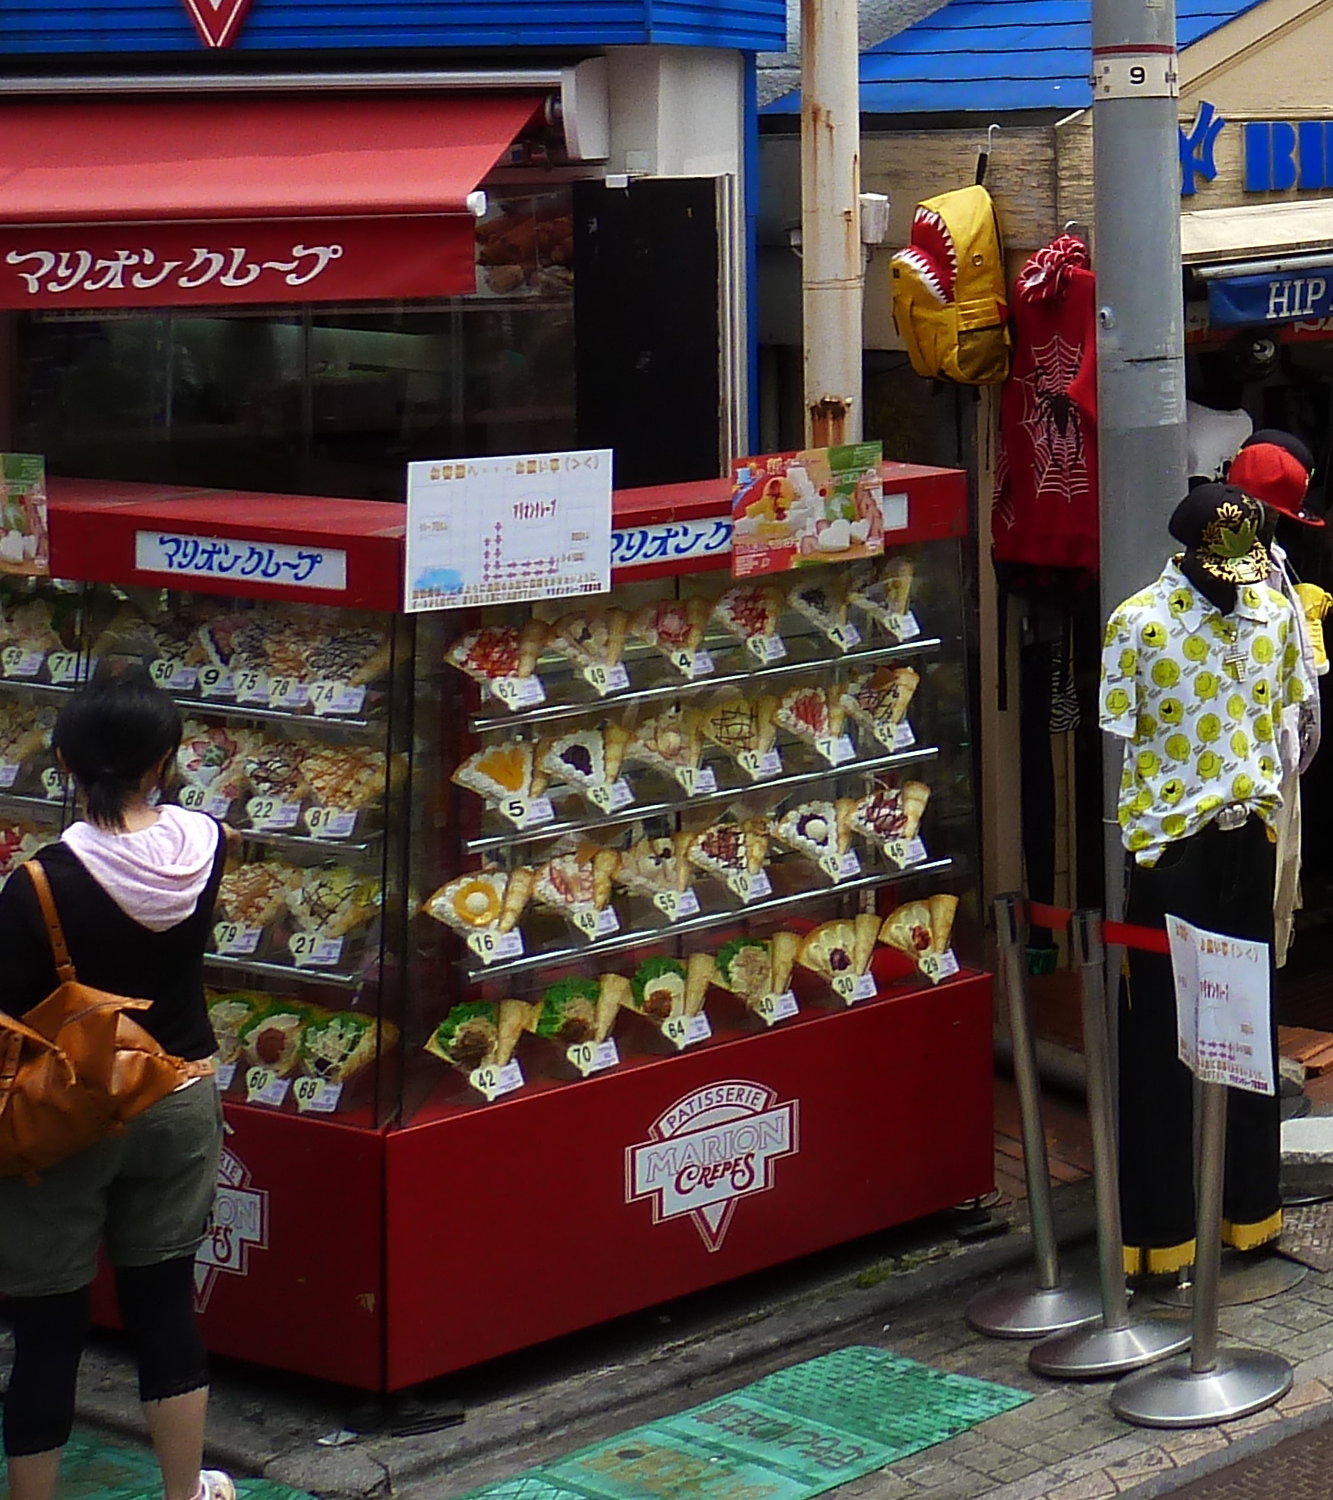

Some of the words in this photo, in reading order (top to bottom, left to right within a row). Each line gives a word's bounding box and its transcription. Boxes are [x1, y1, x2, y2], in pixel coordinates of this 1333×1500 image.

[1130, 66, 1146, 85] 9
[6, 245, 343, 294] マリオンクレープ
[1266, 277, 1326, 320] HIP
[611, 521, 733, 564] マリオンク
[159, 536, 323, 581] マリオンクレープ
[54, 655, 72, 672] 71
[679, 653, 692, 668] 4
[156, 663, 174, 680] 50
[203, 669, 218, 685] 9
[238, 674, 257, 690] 75
[270, 679, 289, 696] 78
[499, 681, 518, 699] 62
[315, 685, 335, 702] 74
[824, 740, 832, 755] 7
[743, 754, 760, 770] 12
[679, 769, 693, 785] 17
[253, 801, 273, 818] 22
[508, 800, 524, 817] 5
[310, 810, 330, 827] 81
[824, 858, 839, 873] 18
[733, 876, 749, 893] 10
[219, 925, 237, 943] 79
[295, 936, 316, 954] 21
[475, 934, 494, 952] 16
[924, 958, 938, 974] 29
[837, 977, 854, 994] 30
[760, 998, 774, 1014] 40
[668, 1019, 685, 1038] 64
[574, 1046, 591, 1065] 70
[249, 1073, 267, 1091] 60
[478, 1070, 496, 1089] 42
[298, 1081, 318, 1100] 68
[666, 1086, 763, 1130] PATISSERIE
[646, 1116, 785, 1183] MARION
[674, 1153, 756, 1195] CREPES
